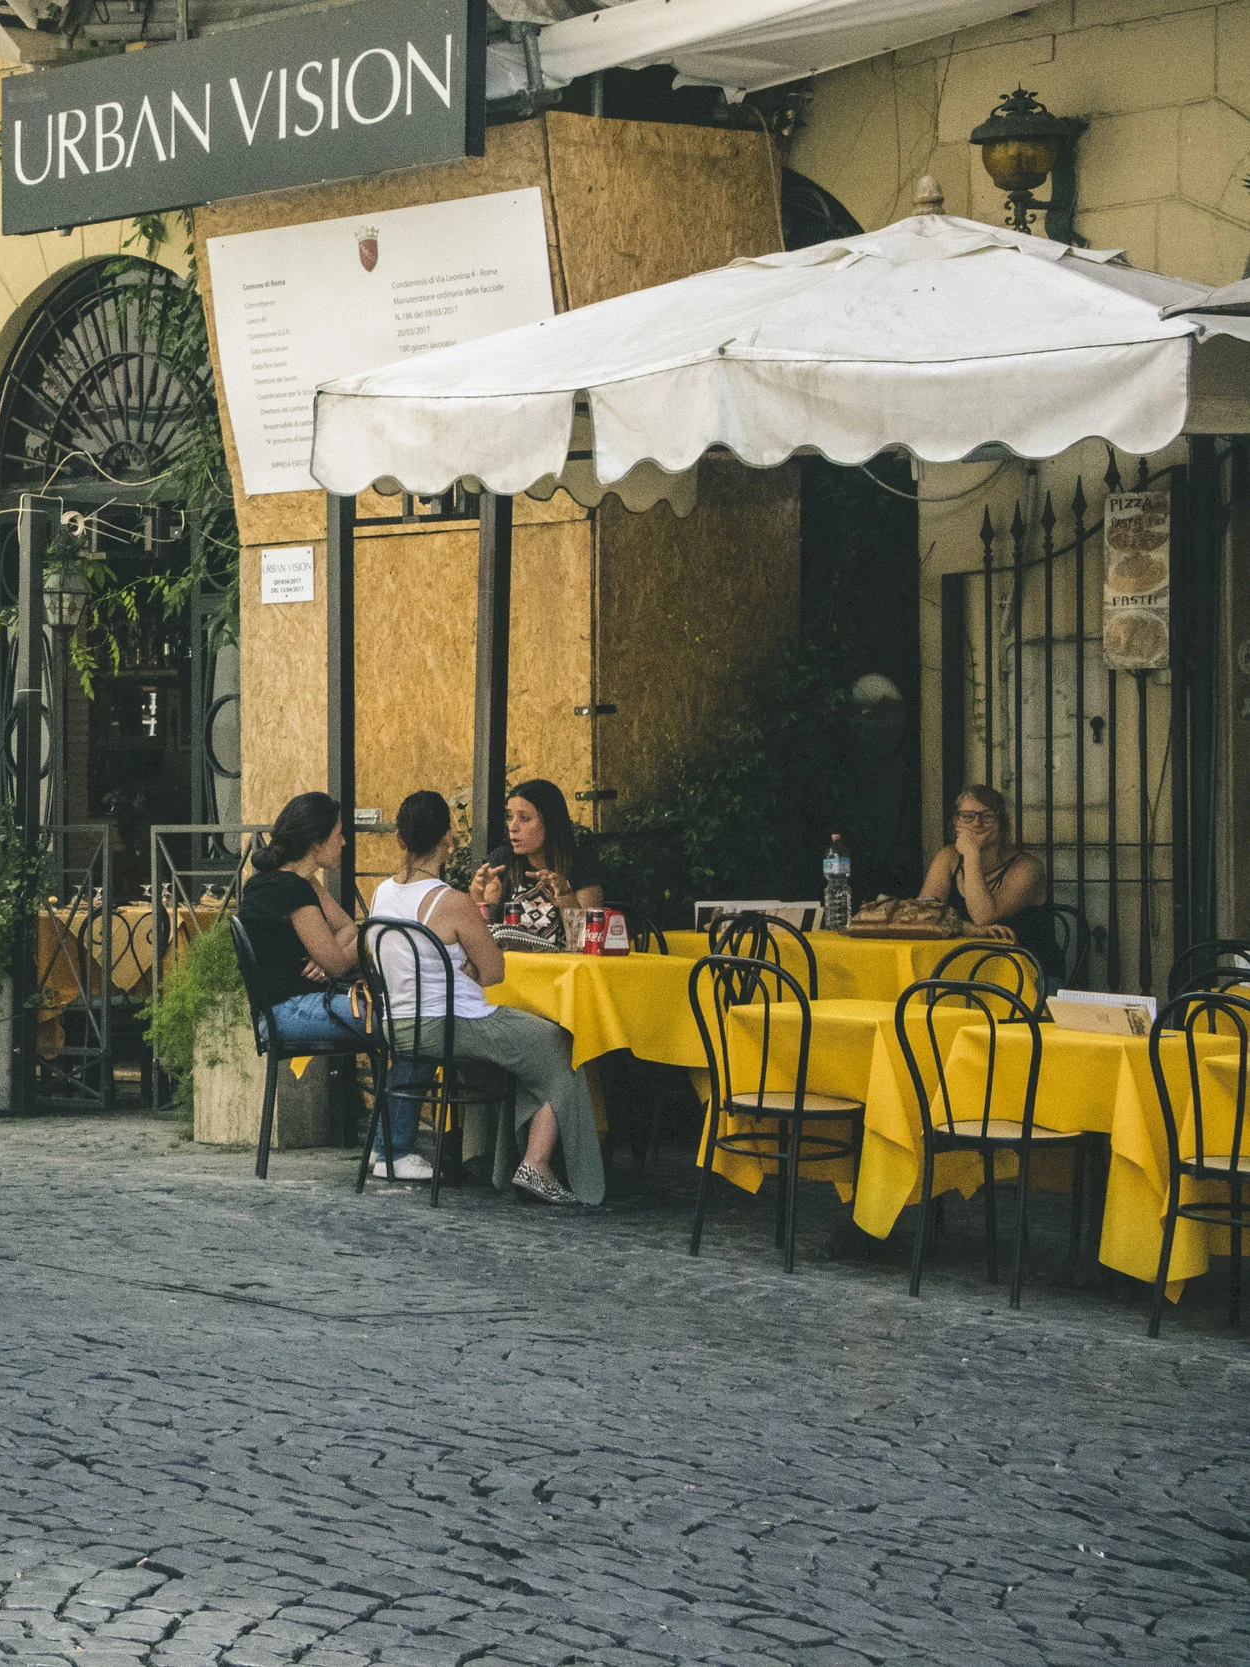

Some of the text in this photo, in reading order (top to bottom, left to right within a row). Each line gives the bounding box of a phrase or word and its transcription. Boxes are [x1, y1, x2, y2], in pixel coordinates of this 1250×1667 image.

[14, 34, 453, 186] URBAN VISION
[391, 278, 428, 290] Condominio
[428, 276, 436, 285] di
[435, 275, 446, 284] Via
[445, 271, 471, 283] Leonina
[471, 270, 476, 278] 4
[479, 268, 499, 277] Roma
[393, 283, 505, 305] Manutenzione ordinaria delle facciate
[414, 310, 424, 318] del
[411, 342, 429, 354] giorni
[1110, 498, 1151, 512] PIZZA
[287, 562, 312, 572] VISION
